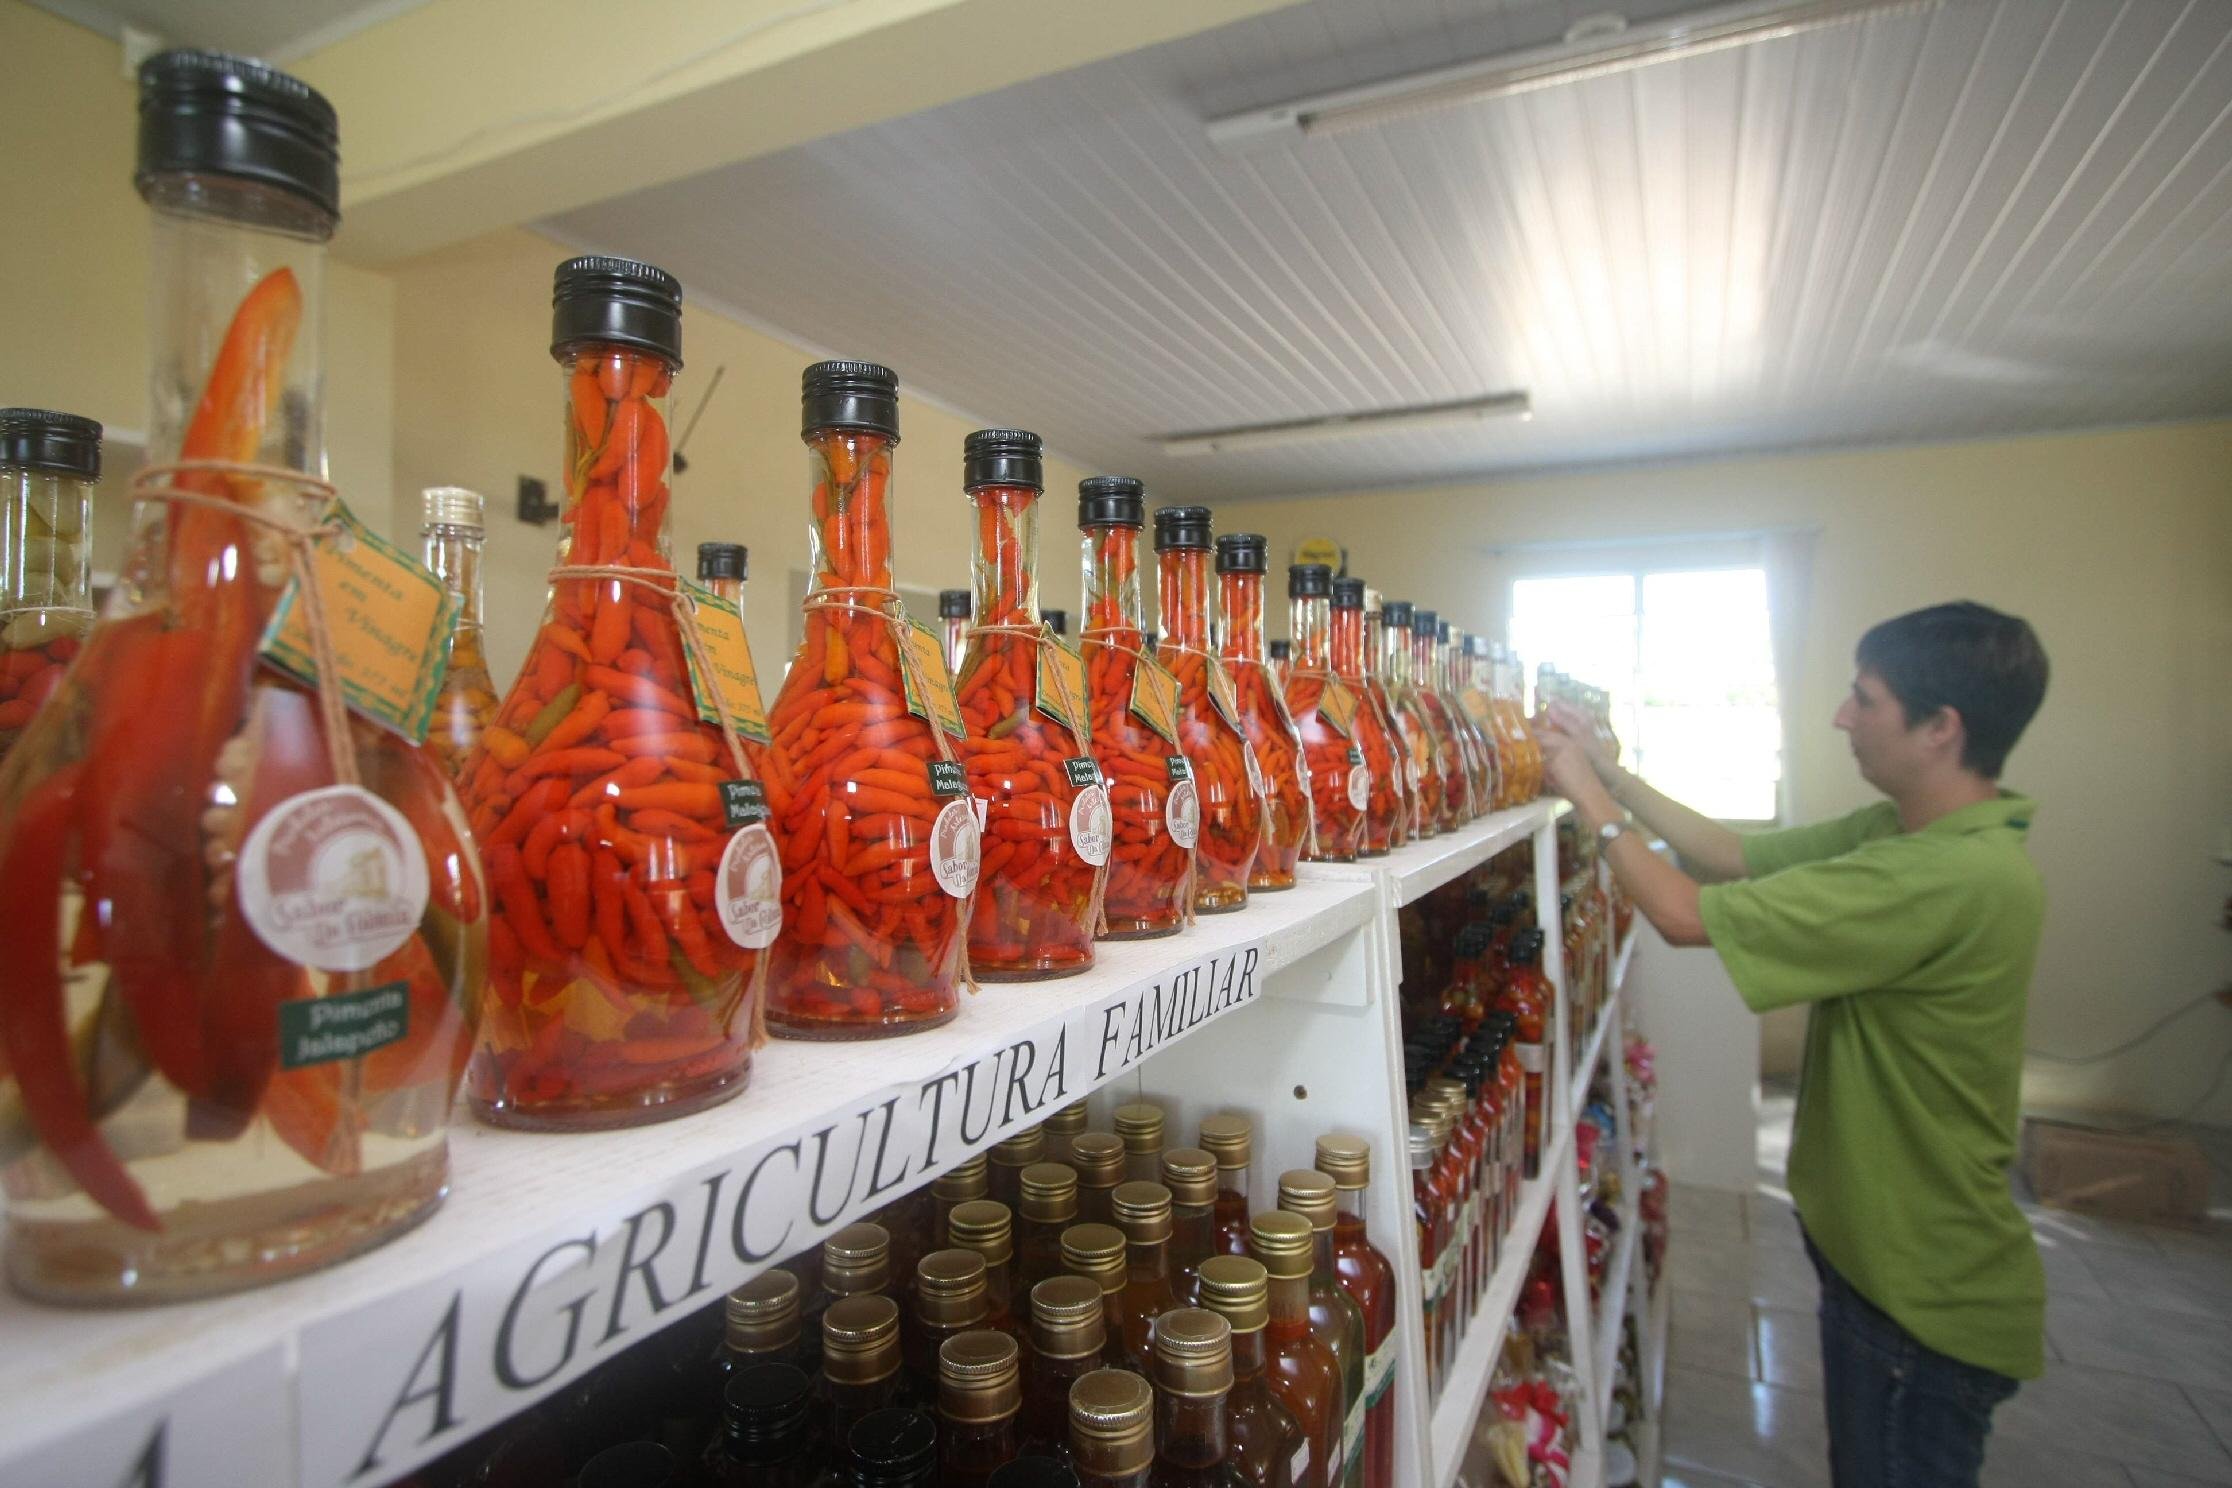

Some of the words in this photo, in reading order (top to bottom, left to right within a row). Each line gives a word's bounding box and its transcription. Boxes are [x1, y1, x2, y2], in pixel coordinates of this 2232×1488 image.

[309, 991, 403, 1030] Pimenta
[341, 1021, 1068, 1485] AGRICULTURA
[1094, 947, 1259, 1081] FAMILIAR
